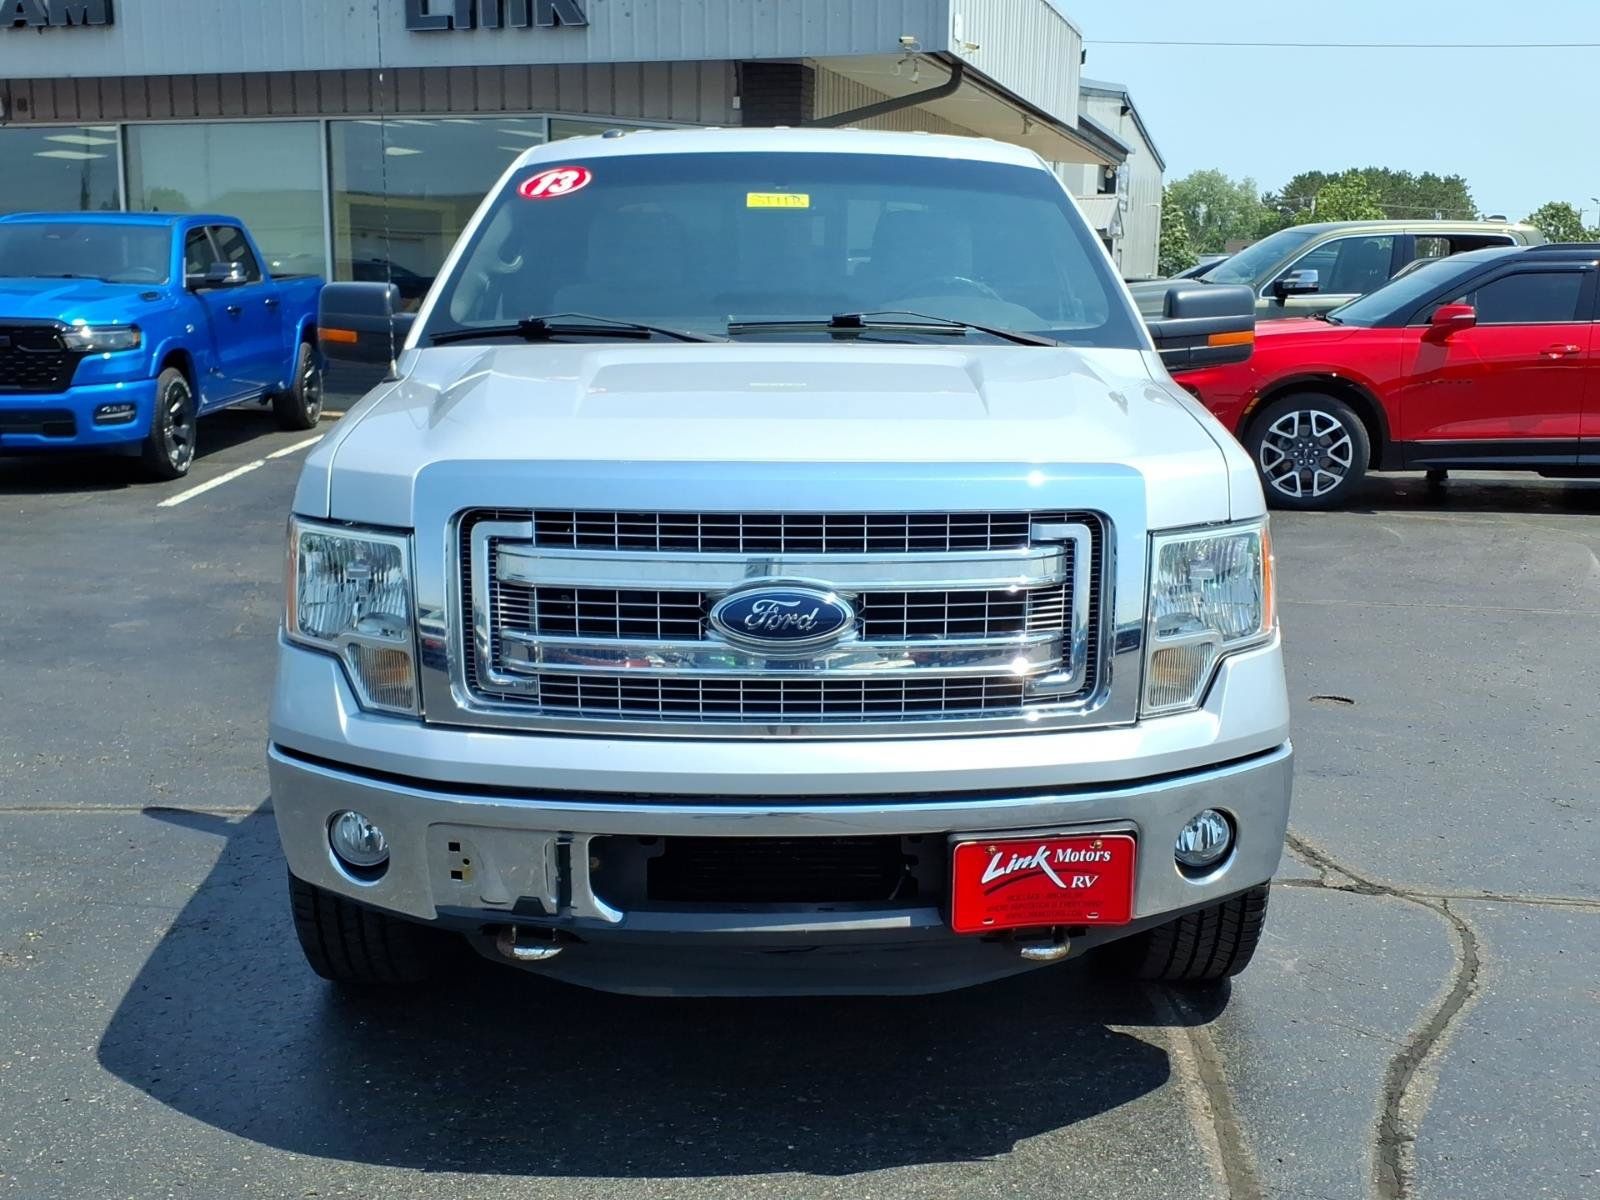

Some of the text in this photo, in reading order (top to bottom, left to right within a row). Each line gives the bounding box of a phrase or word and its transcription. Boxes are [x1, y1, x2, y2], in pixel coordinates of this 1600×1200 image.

[530, 170, 580, 196] 13
[744, 599, 820, 631] Ford
[981, 845, 1111, 888] Link Motors
[1071, 875, 1099, 888] RV
